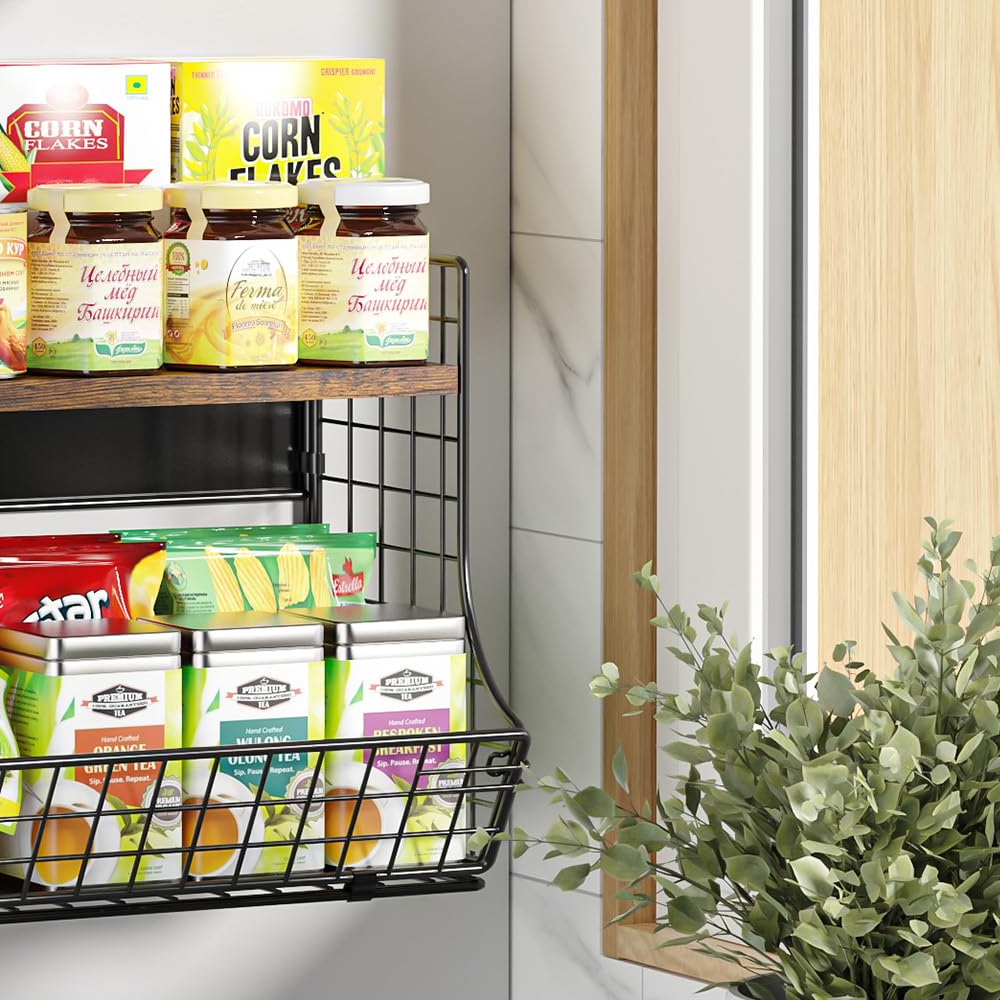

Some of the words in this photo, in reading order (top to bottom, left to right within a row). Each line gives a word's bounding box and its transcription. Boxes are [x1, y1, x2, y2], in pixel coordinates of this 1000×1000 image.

[24, 119, 104, 138] CORN
[25, 138, 108, 151] FLAKES
[243, 114, 320, 162] CORN
[351, 256, 427, 280] Целебный
[80, 264, 159, 287] Целебный
[230, 279, 283, 300] Ferma
[334, 577, 362, 593] Estrella
[23, 589, 110, 623] tar
[385, 677, 429, 686] PREMIUM
[242, 685, 287, 694] PREMIUM
[97, 692, 143, 702] PREMIUM
[278, 752, 300, 762] TEA
[133, 761, 156, 771] TEA
[247, 767, 265, 775] Paus
[104, 776, 125, 784] ause.
[126, 775, 151, 784] Repeat.
